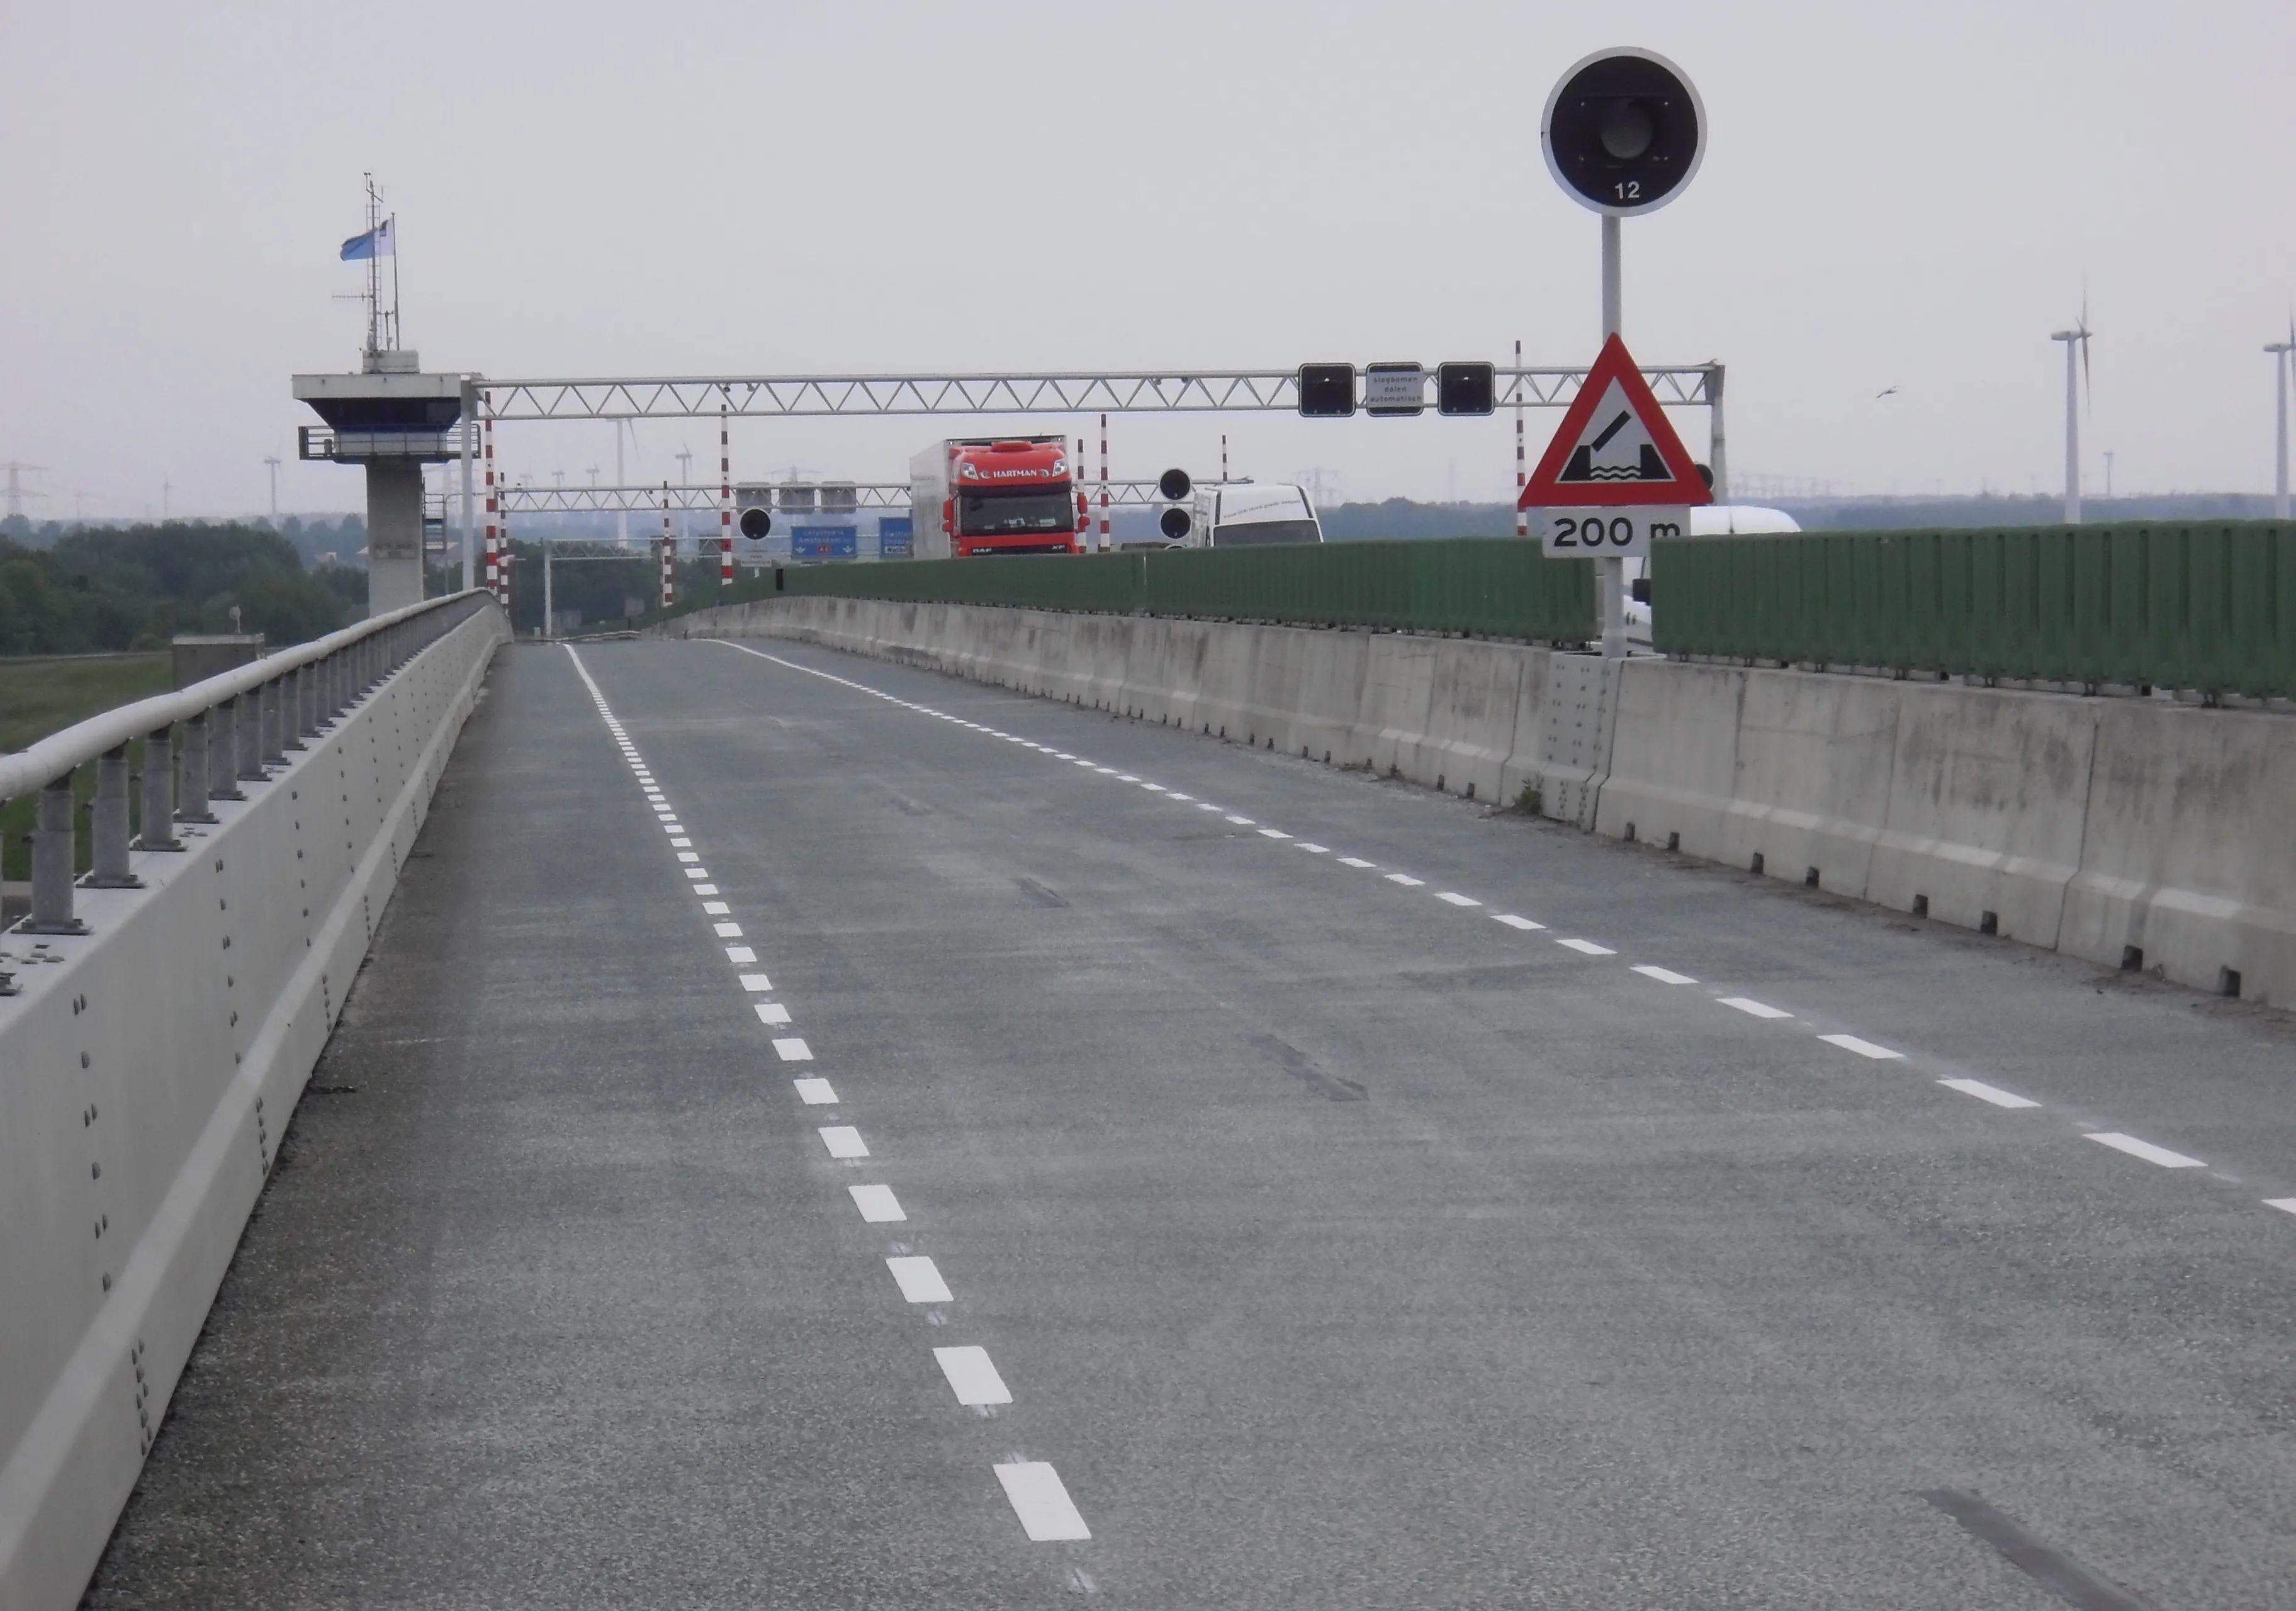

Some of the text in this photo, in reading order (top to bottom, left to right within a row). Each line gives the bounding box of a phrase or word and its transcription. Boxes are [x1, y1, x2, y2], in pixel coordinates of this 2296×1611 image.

[1614, 181, 1640, 199] 12
[1370, 395, 1422, 403] automatisch
[993, 469, 1037, 478] HARTMAN
[1554, 517, 1680, 547] 200 m
